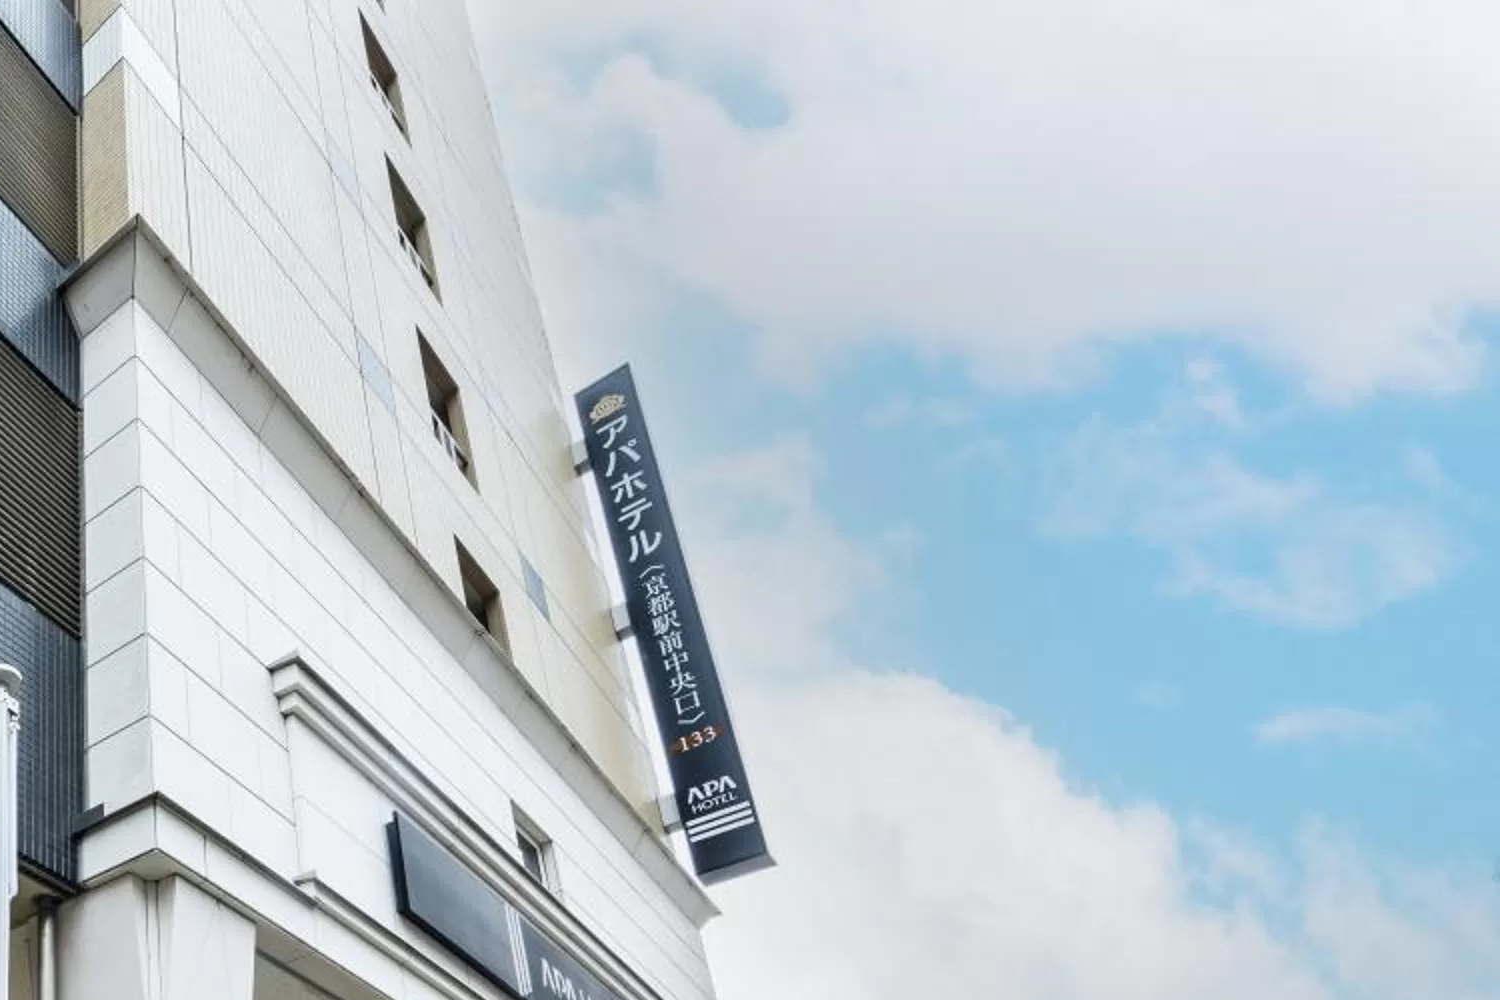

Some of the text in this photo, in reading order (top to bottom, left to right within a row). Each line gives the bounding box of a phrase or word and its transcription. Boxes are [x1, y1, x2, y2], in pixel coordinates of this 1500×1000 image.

[680, 726, 717, 753] 133
[687, 775, 737, 804] APA
[691, 792, 738, 815] HOTEL
